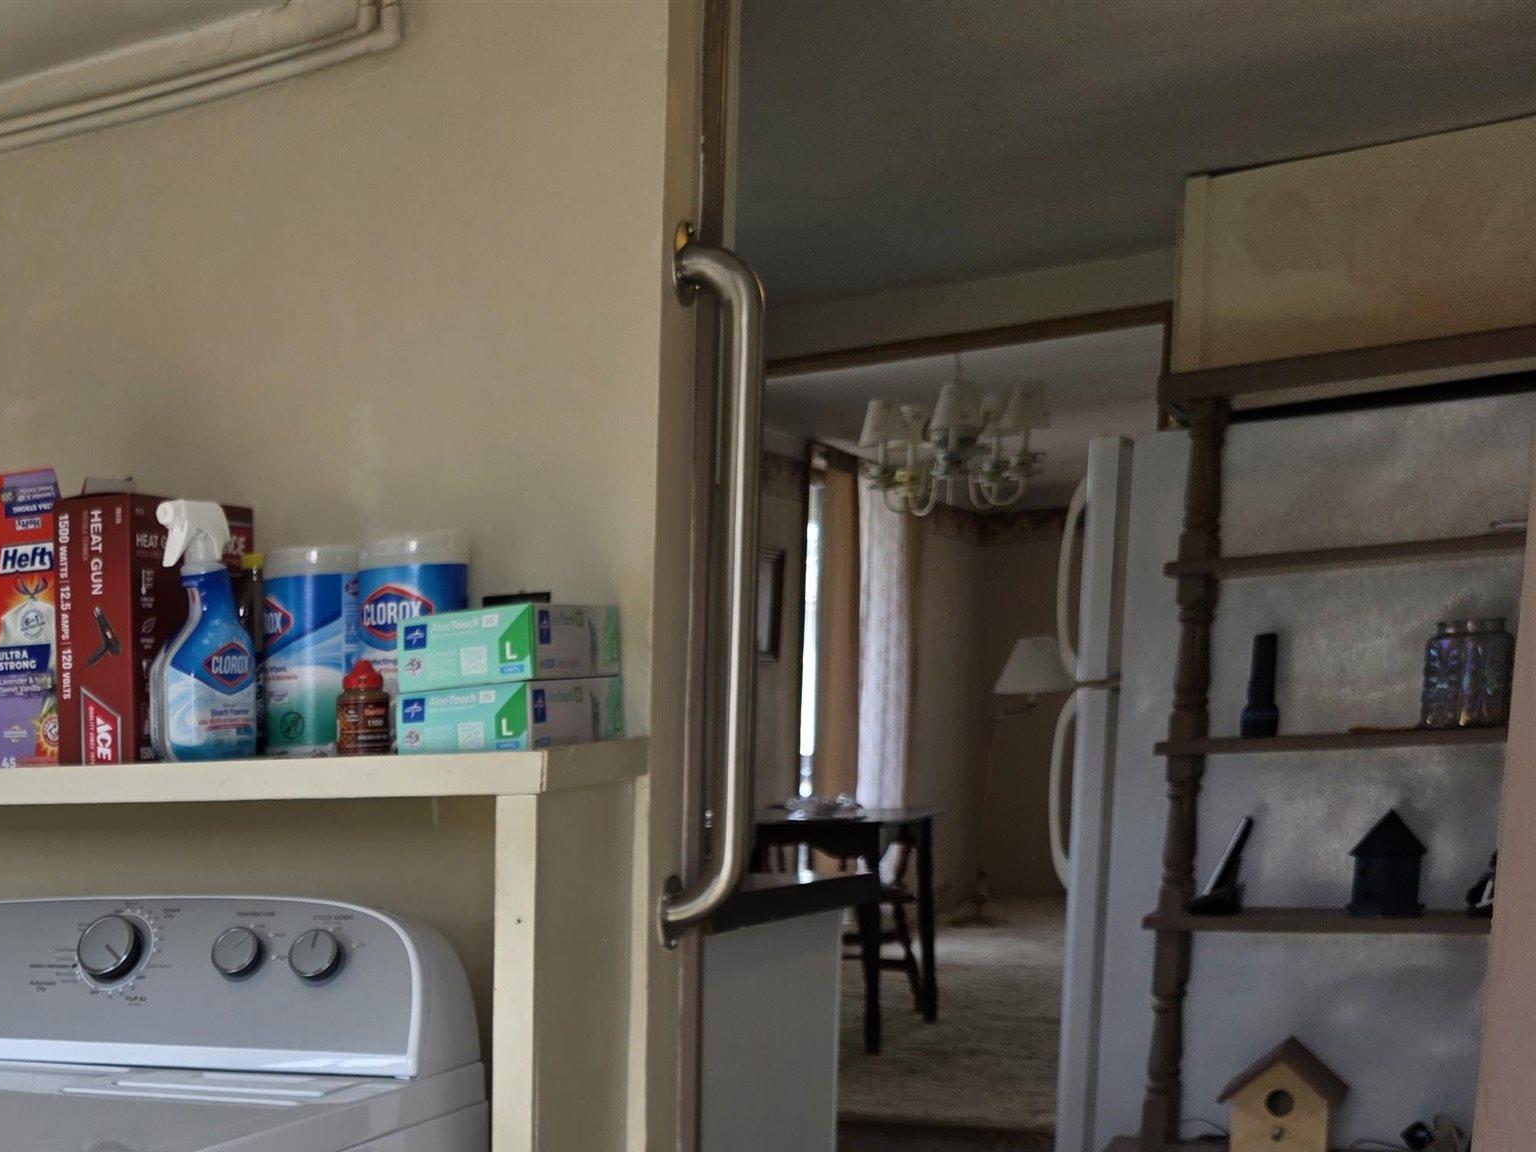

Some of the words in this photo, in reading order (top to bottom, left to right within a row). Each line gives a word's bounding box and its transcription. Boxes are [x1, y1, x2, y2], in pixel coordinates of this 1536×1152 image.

[58, 513, 70, 544] 1500
[90, 510, 103, 553] HEAT
[136, 533, 159, 548] HEAT
[59, 545, 69, 579] WATTS
[90, 558, 103, 595] GUN
[60, 586, 71, 611] 12.5
[61, 613, 70, 640] AMPS
[363, 601, 422, 626] CLOROX
[62, 649, 73, 670] 120
[505, 642, 518, 660] L
[211, 656, 249, 674] CLOROX
[63, 672, 72, 700] VOLTS
[96, 717, 113, 761] ACE
[501, 718, 513, 736] L
